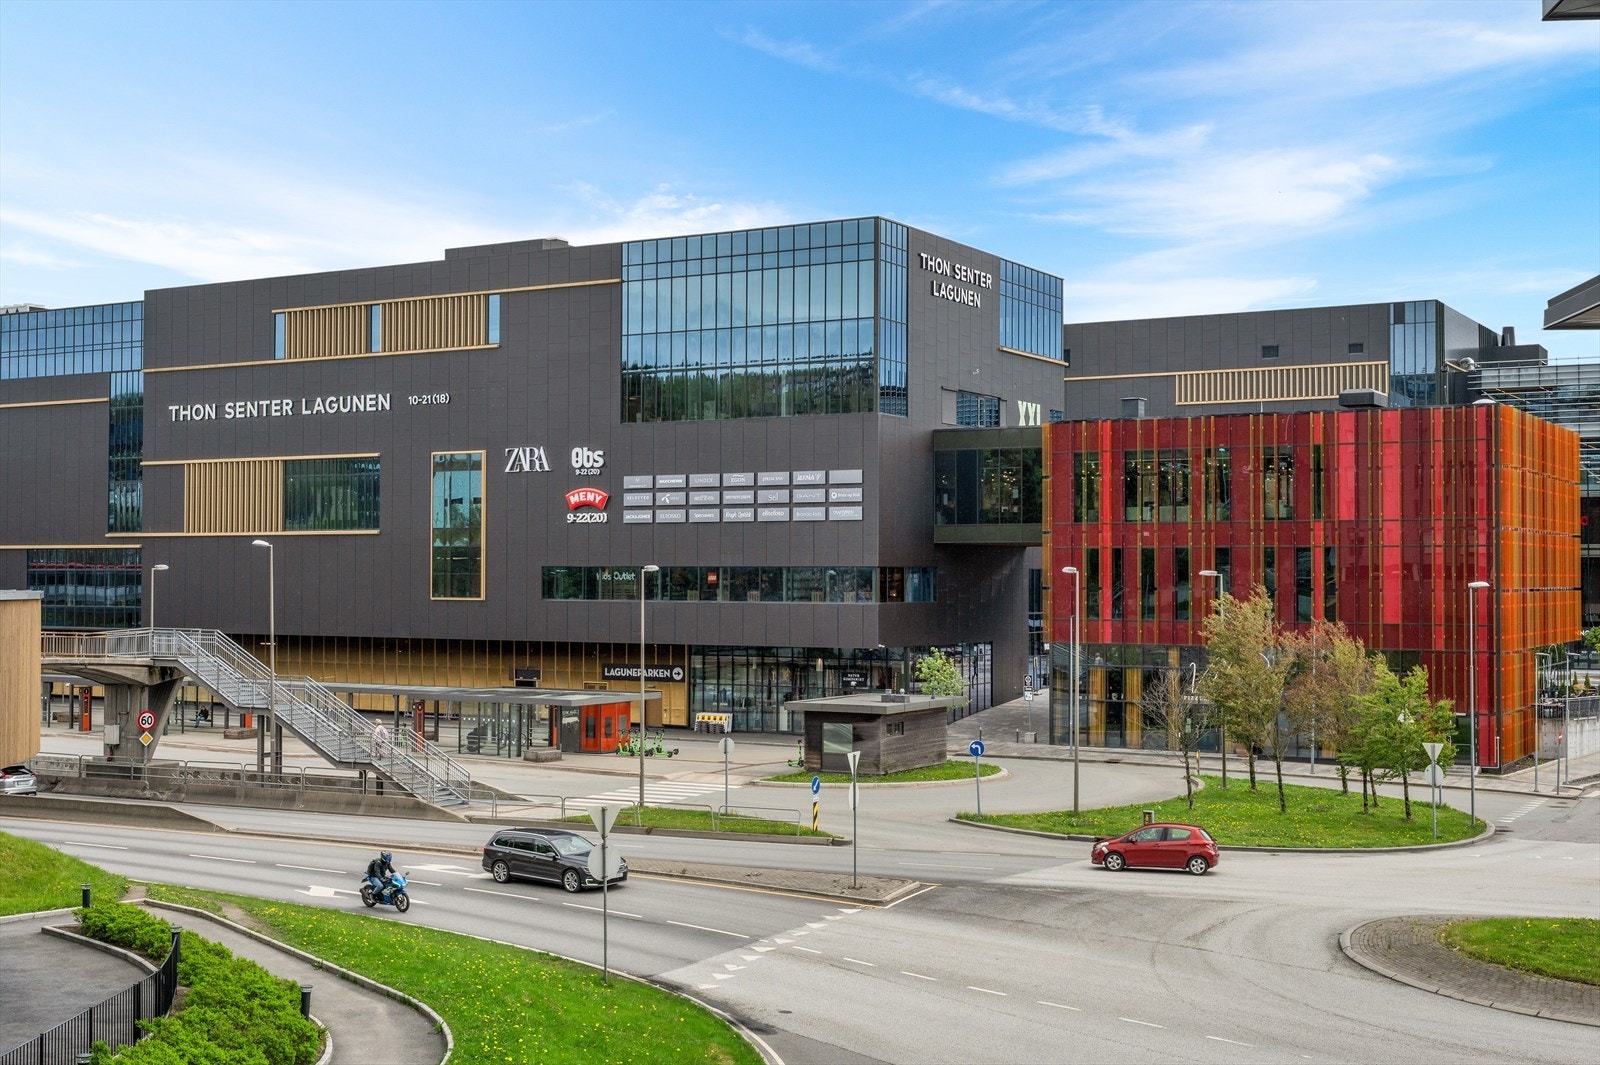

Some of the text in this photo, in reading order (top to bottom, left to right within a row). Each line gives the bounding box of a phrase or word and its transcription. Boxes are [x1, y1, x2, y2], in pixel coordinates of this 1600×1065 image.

[920, 252, 993, 290] THON SENTER
[932, 280, 981, 309] LAGUNEN
[168, 404, 217, 422] THON
[224, 399, 293, 419] SENTER
[301, 393, 391, 416] LAGUNEN
[1017, 400, 1041, 427] XXI
[504, 446, 552, 473] ZARA
[571, 446, 605, 469] Obs
[569, 491, 603, 505] MENY
[613, 571, 636, 581] Outlet
[604, 667, 671, 678] LAGUNEPARKEN
[141, 715, 153, 726] 60
